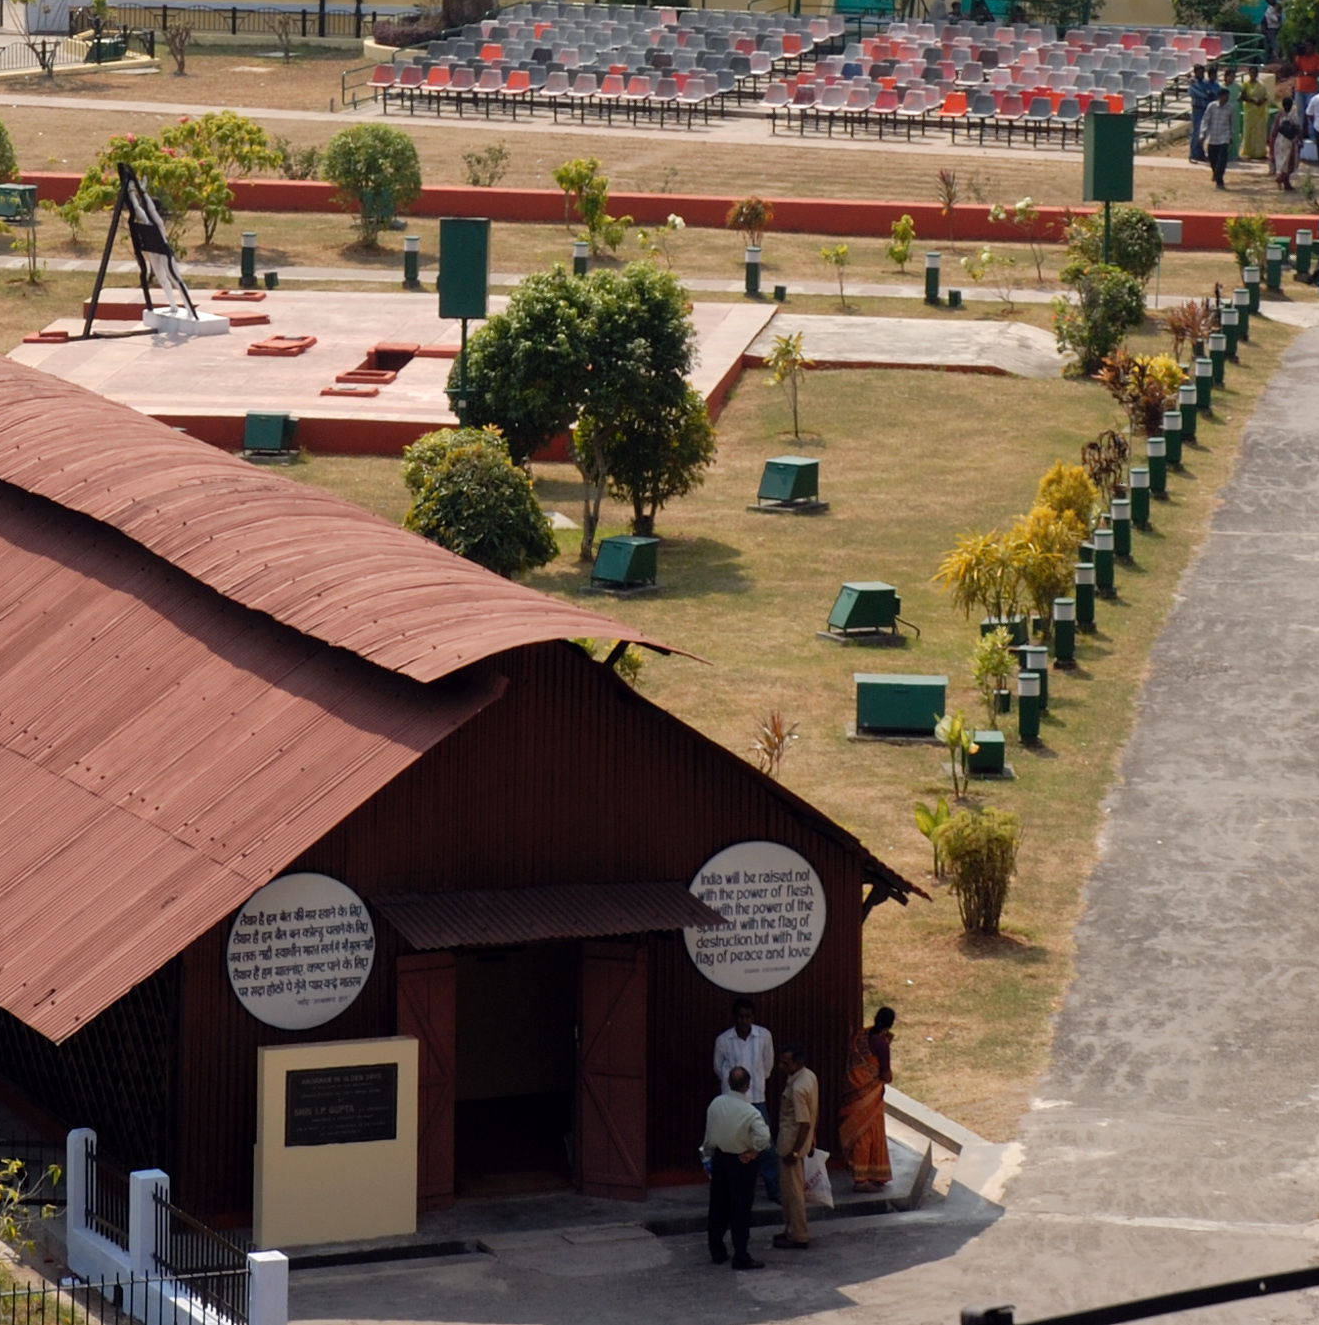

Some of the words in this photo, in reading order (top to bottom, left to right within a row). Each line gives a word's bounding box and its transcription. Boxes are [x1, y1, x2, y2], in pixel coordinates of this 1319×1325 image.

[701, 873, 722, 885] India
[726, 871, 740, 884] will
[744, 870, 756, 884] be
[759, 870, 792, 882] raised
[796, 869, 810, 882] not
[698, 888, 717, 902] with
[720, 888, 734, 900] the
[737, 888, 768, 901] power
[771, 884, 784, 897] of
[338, 904, 348, 917] के
[736, 902, 750, 914] the
[752, 902, 783, 916] power
[785, 900, 796, 912] of
[798, 899, 814, 912] the
[740, 917, 758, 930] with
[760, 916, 776, 929] the
[778, 915, 798, 930] flag
[800, 914, 810, 927] of
[754, 932, 769, 945] but
[772, 930, 792, 944] with
[797, 930, 812, 942] the
[342, 957, 353, 969] के
[696, 950, 714, 966] flag
[716, 948, 728, 963] of
[730, 950, 762, 964] peace
[766, 947, 784, 960] and
[788, 946, 811, 958] love
[238, 987, 249, 996] पर
